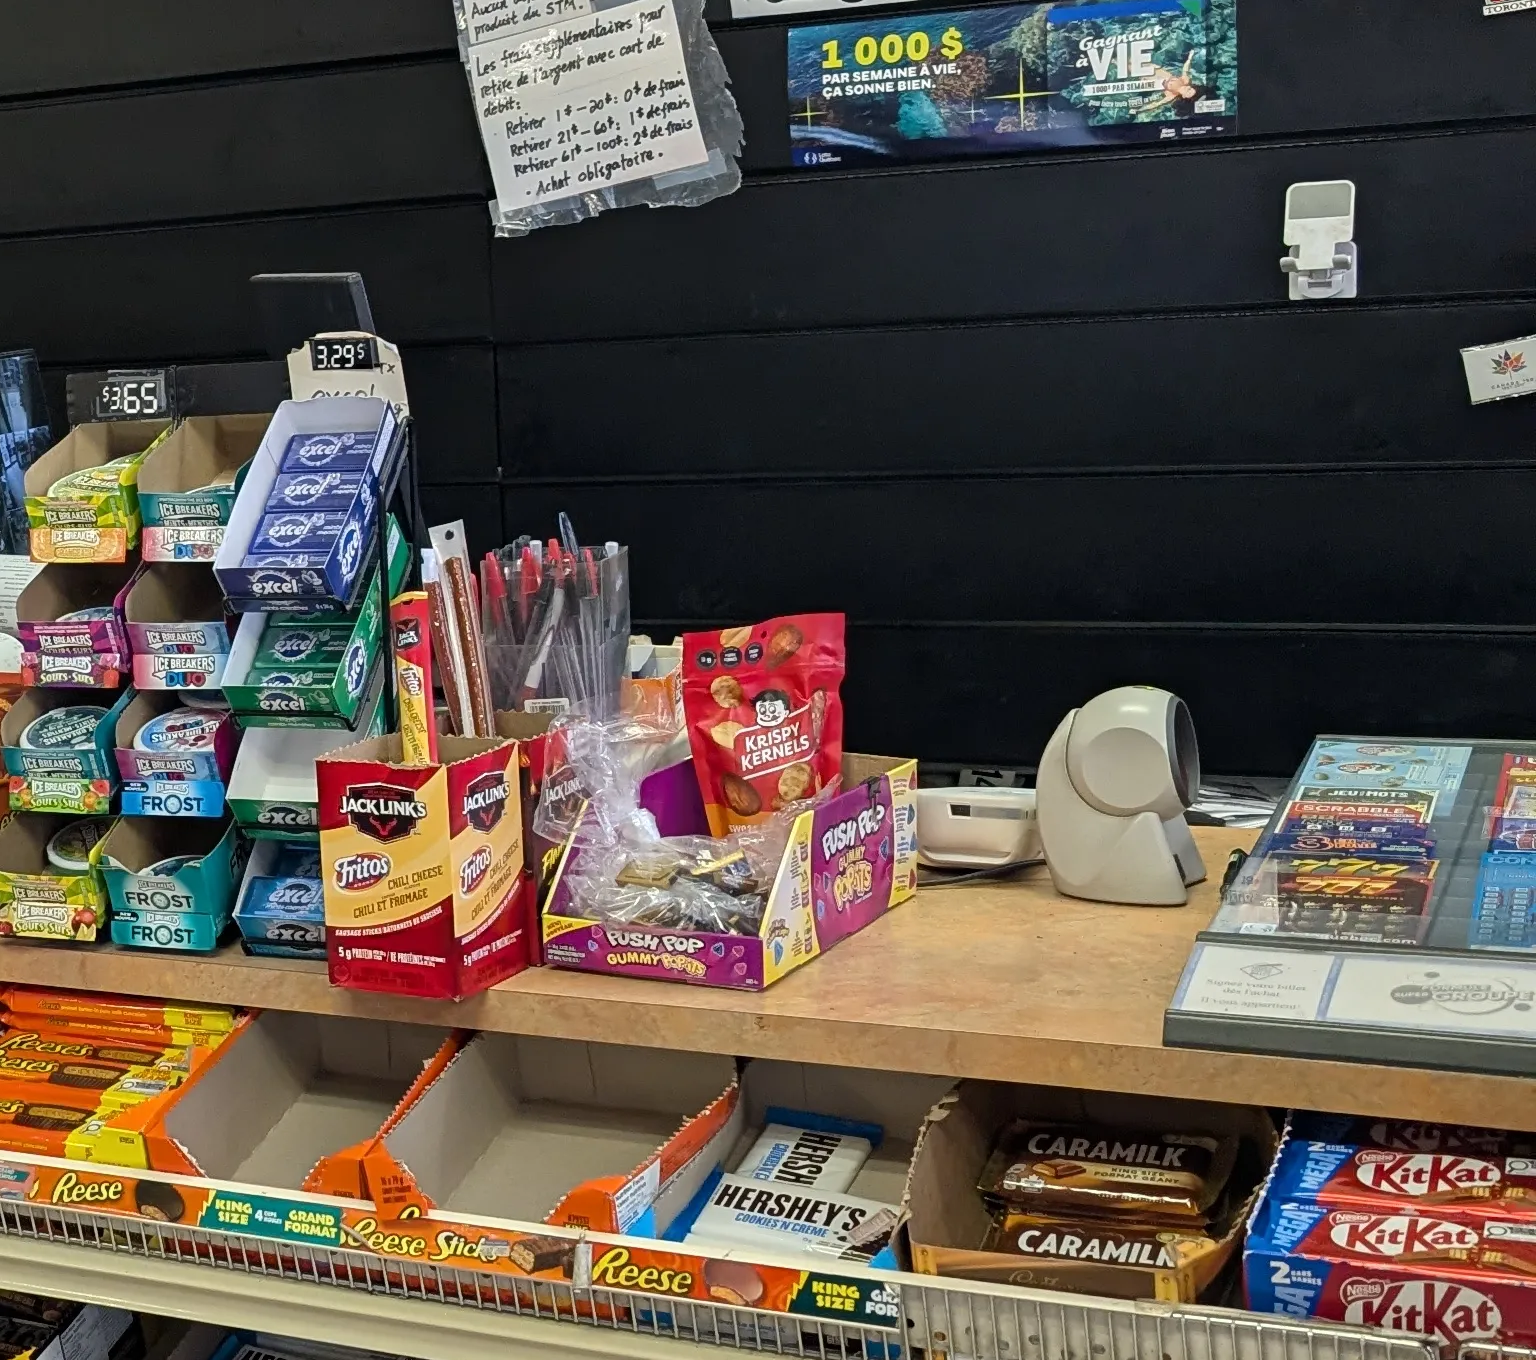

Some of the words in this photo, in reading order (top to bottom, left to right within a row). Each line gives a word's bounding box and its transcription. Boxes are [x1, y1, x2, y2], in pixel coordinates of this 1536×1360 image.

[472, 0, 508, 19] Aucun
[474, 12, 518, 41] produit
[523, 6, 541, 21] du
[855, 32, 929, 65] 000
[1079, 25, 1163, 51] Gagnant
[476, 56, 496, 77] Les
[517, 71, 528, 87] de
[587, 49, 615, 67] avec
[1076, 55, 1088, 68] à
[1087, 40, 1154, 81] VIE
[822, 74, 849, 85] PAR
[853, 67, 917, 81] SEMAINE
[932, 63, 961, 75] VIE,
[822, 88, 844, 100] ÇA
[845, 83, 894, 95] SONNE
[898, 79, 936, 90] BIEN.
[1112, 84, 1125, 92] PAR
[1127, 82, 1155, 90] SEMAINE
[536, 171, 570, 196] Achat
[165, 529, 177, 542] ICE
[178, 528, 223, 542] BREAKERS
[252, 577, 298, 596] excel
[155, 656, 169, 669] ICE
[170, 655, 214, 670] BREAKERS
[166, 672, 207, 687] DUO
[744, 722, 802, 754] KRISPY
[740, 734, 810, 771] KERNELS
[142, 795, 204, 814] FROST
[340, 796, 379, 815] JACK
[379, 799, 427, 818] LINK'S
[1304, 803, 1406, 815] SCRABBLE
[335, 853, 389, 888] Fritos
[388, 877, 410, 890] CHILI
[412, 865, 443, 883] CHEESE
[353, 902, 376, 919] CHILI
[390, 888, 428, 909] FROMAGE
[132, 925, 195, 945] FROST
[607, 928, 661, 949] PUSH
[662, 935, 705, 954] POP
[607, 952, 661, 967] GUMMY
[0, 1034, 94, 1059] Reese's
[1028, 1133, 1184, 1168] CARAMILK
[1370, 1156, 1501, 1195] KitKat
[52, 1174, 123, 1204] Reese
[214, 1197, 253, 1214] KING
[217, 1210, 249, 1225] SIZE
[288, 1210, 335, 1226] GRAND
[714, 1184, 869, 1232] HERSHEY'S
[284, 1222, 337, 1240] FORMAT
[1343, 1217, 1477, 1255] KitKat
[1018, 1229, 1178, 1268] CARAMILK
[592, 1247, 693, 1294] Reese
